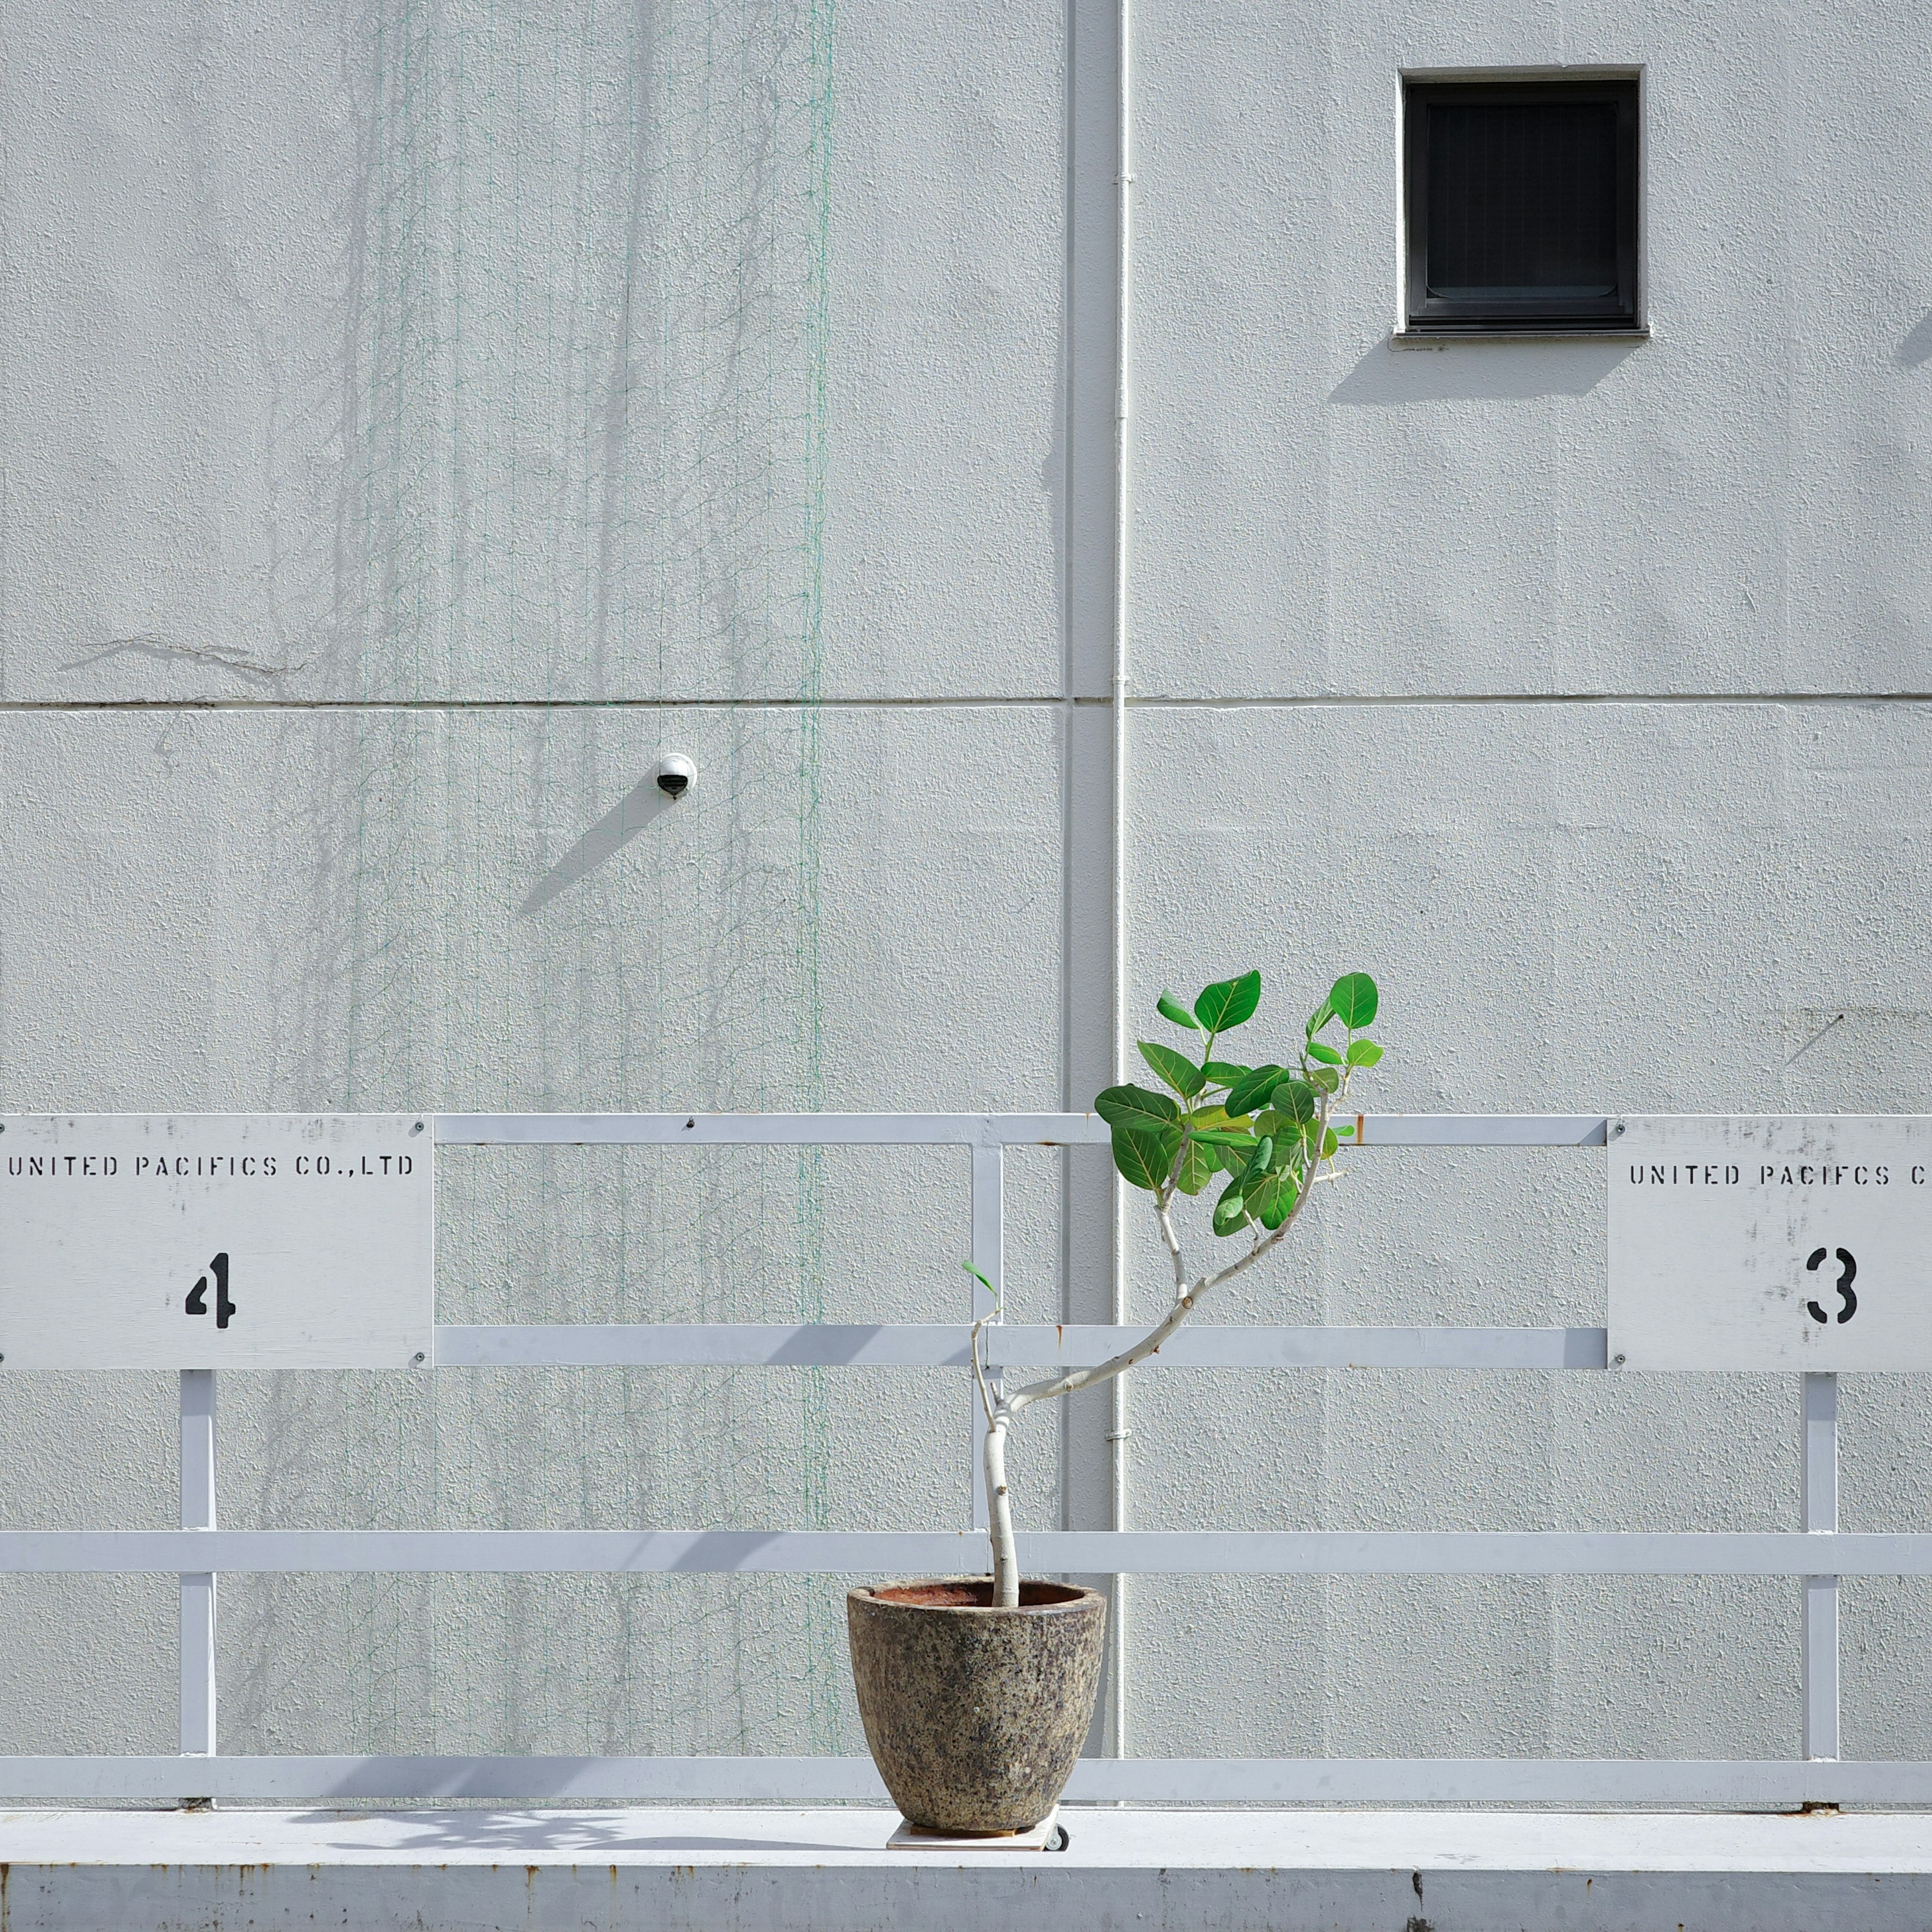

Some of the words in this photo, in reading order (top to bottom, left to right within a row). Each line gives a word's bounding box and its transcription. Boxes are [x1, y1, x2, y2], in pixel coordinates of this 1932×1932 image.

[9, 1156, 117, 1176] UNITED
[136, 1156, 276, 1176] PACIFICS
[296, 1156, 412, 1178] CO.,LTD
[1630, 1165, 1739, 1185] UNITED
[1761, 1165, 1889, 1185] PACIFCS
[185, 1253, 236, 1329] 4
[1806, 1247, 1858, 1324] 3
